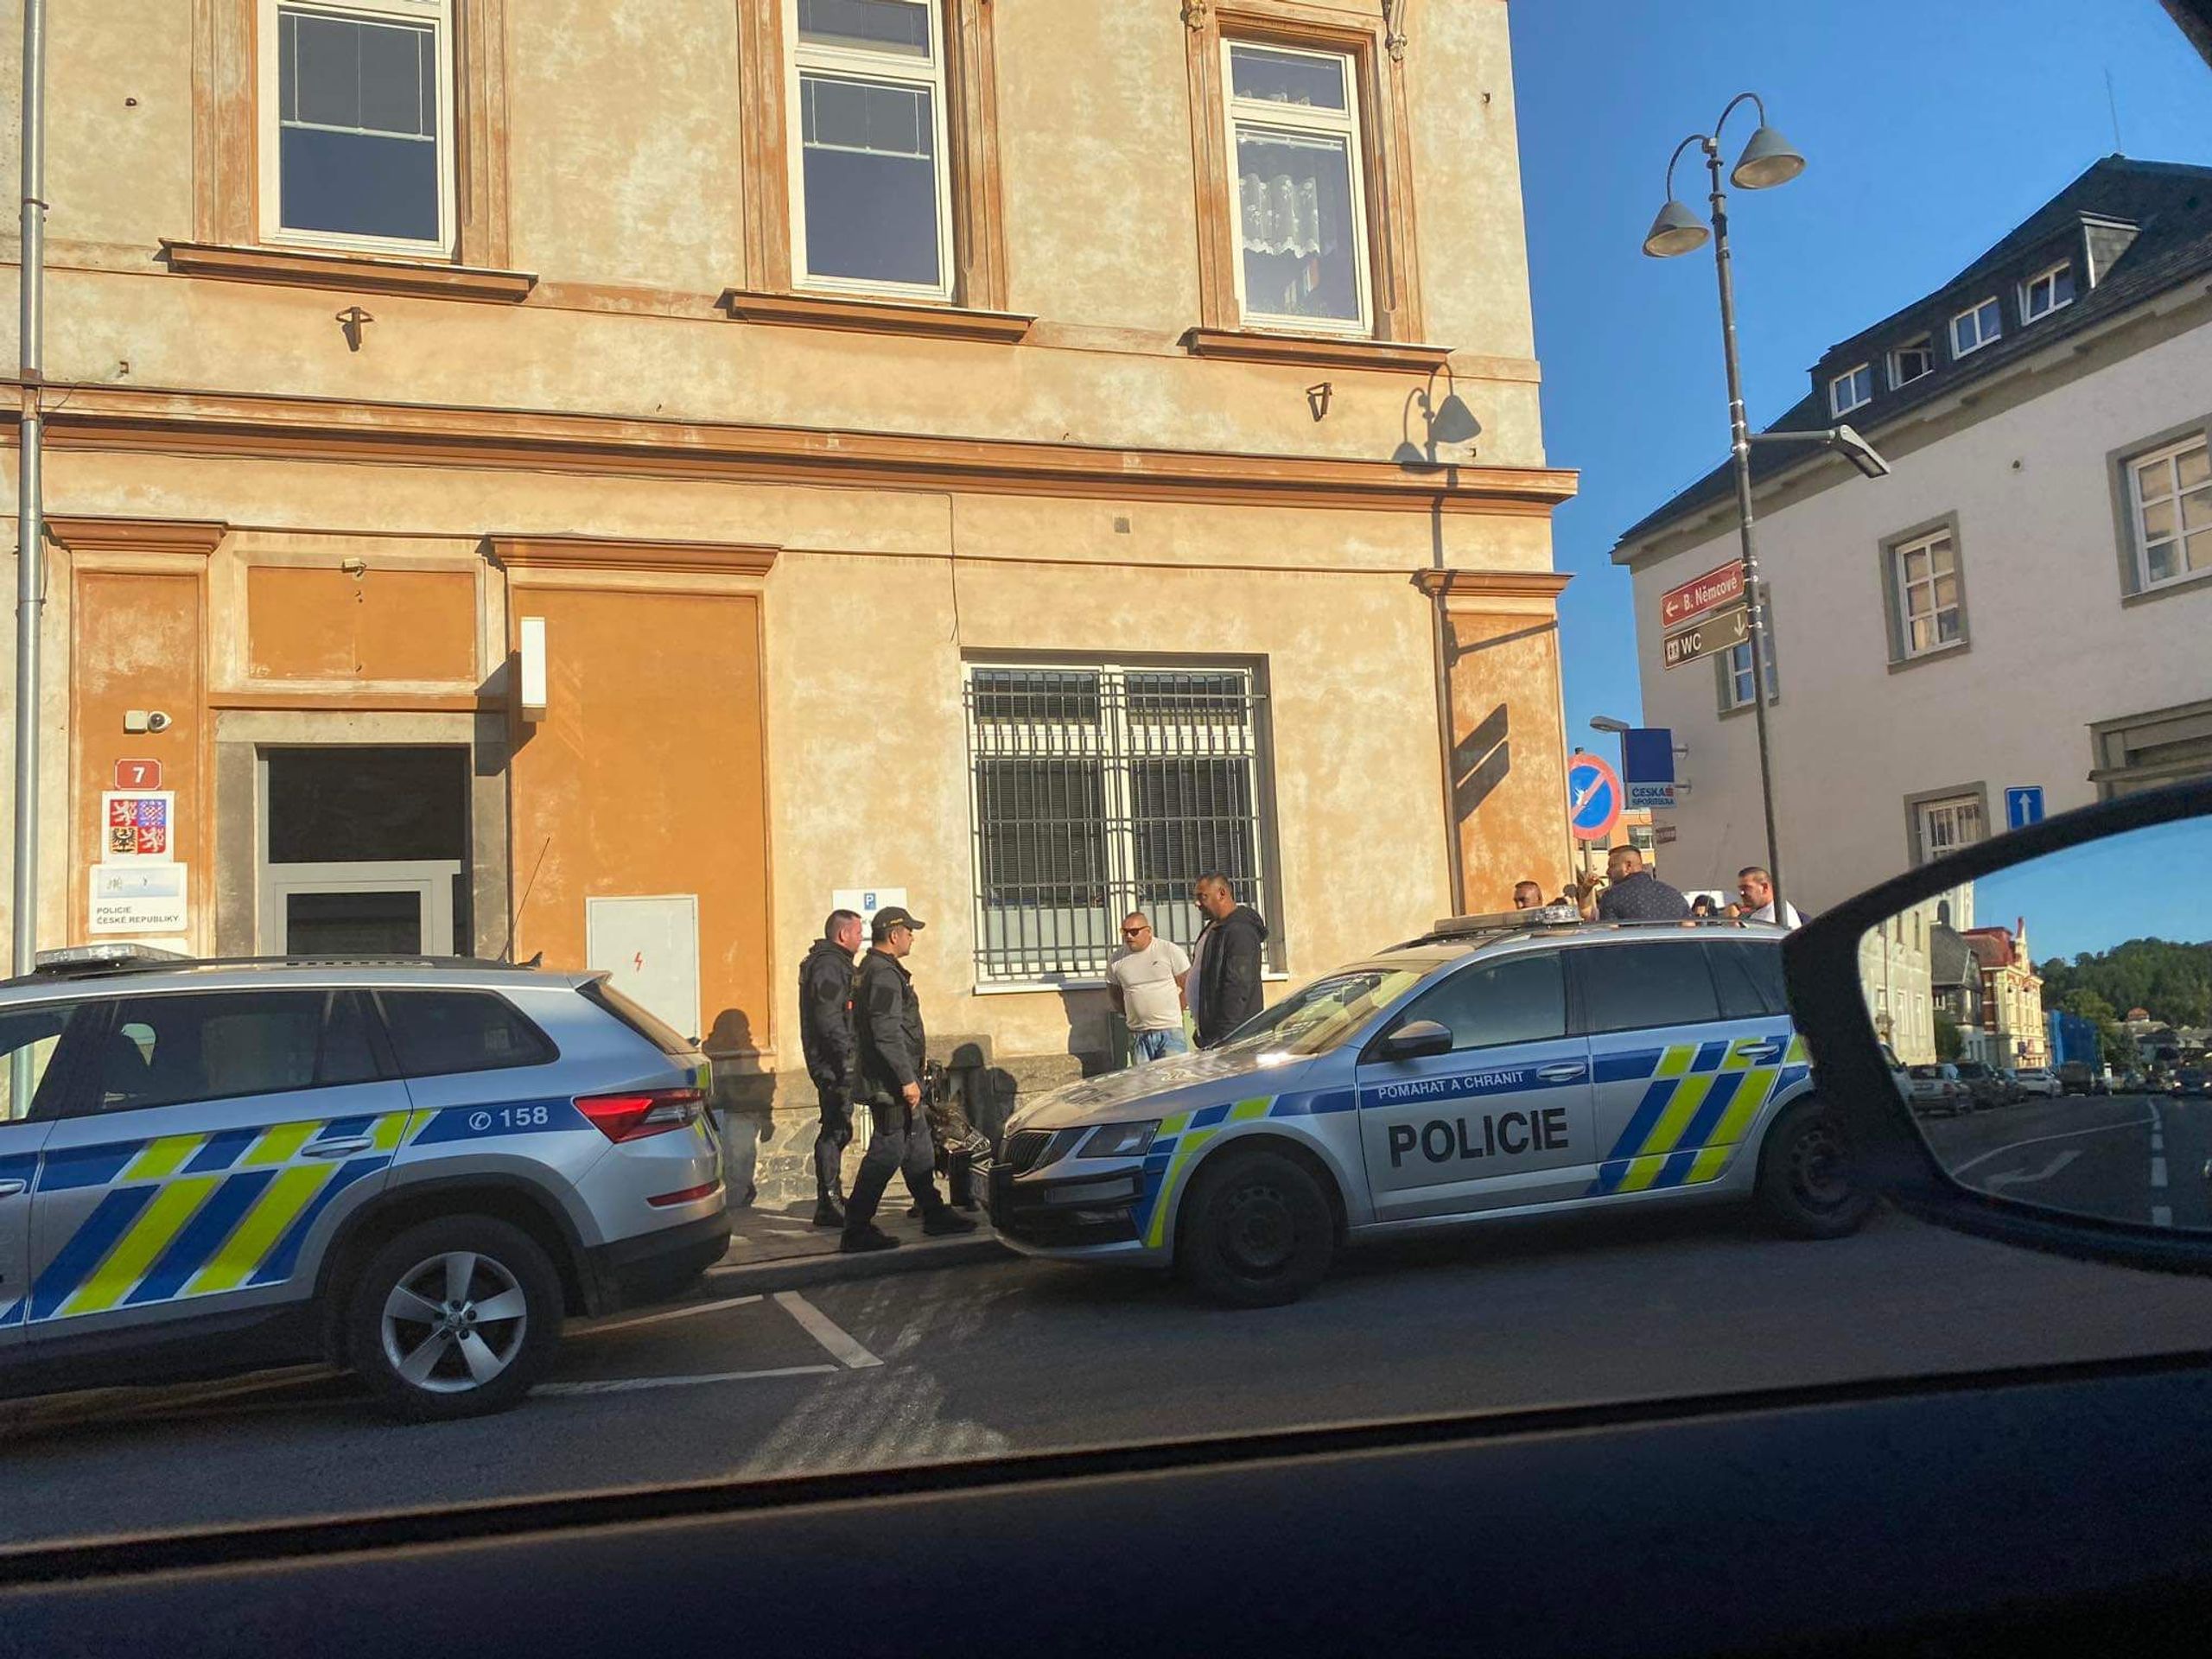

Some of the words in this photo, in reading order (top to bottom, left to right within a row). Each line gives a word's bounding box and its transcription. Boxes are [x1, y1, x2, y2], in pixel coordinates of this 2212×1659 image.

[1683, 594, 1694, 611] B.
[1695, 572, 1738, 606] Němcové
[1681, 632, 1702, 655] WC
[132, 766, 145, 784] 7
[866, 894, 874, 906] P
[129, 915, 179, 924] REPUBLIKY
[1451, 1078, 1462, 1090] A
[499, 1106, 549, 1128] 158
[1389, 1108, 1568, 1167] POLICIE
